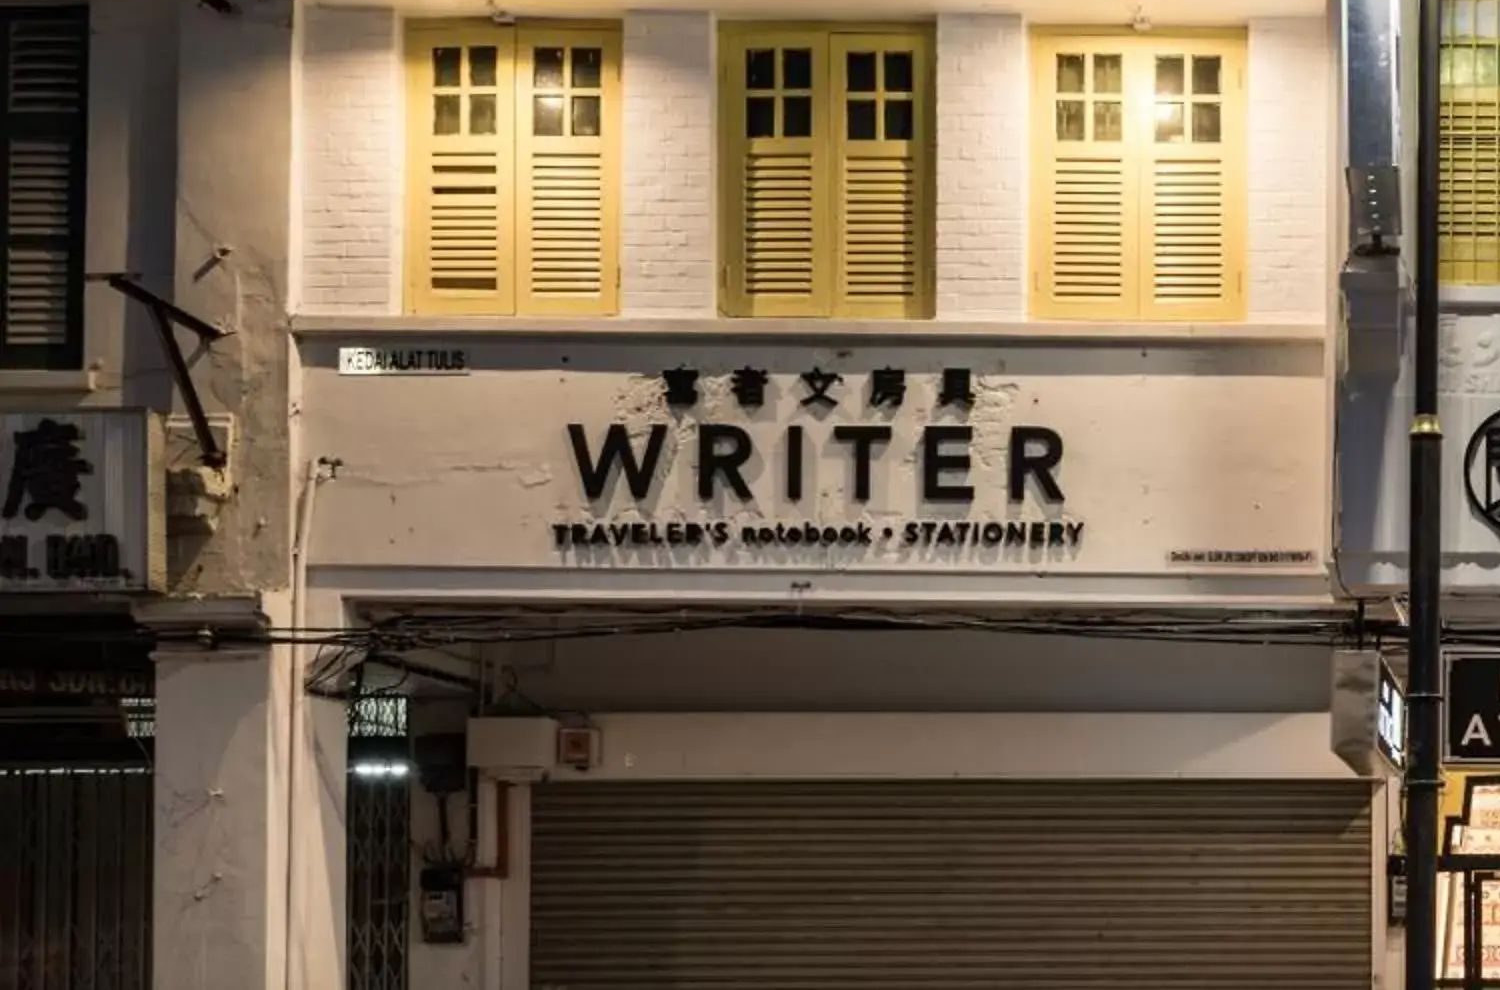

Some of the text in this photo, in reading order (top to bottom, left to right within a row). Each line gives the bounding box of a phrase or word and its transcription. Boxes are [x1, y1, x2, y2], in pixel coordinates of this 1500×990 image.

[347, 349, 465, 370] KEDAI ALAT TULIS
[567, 423, 1065, 501] WRITER
[552, 521, 1085, 548] TRAVELER'S notebook STATIONERY
